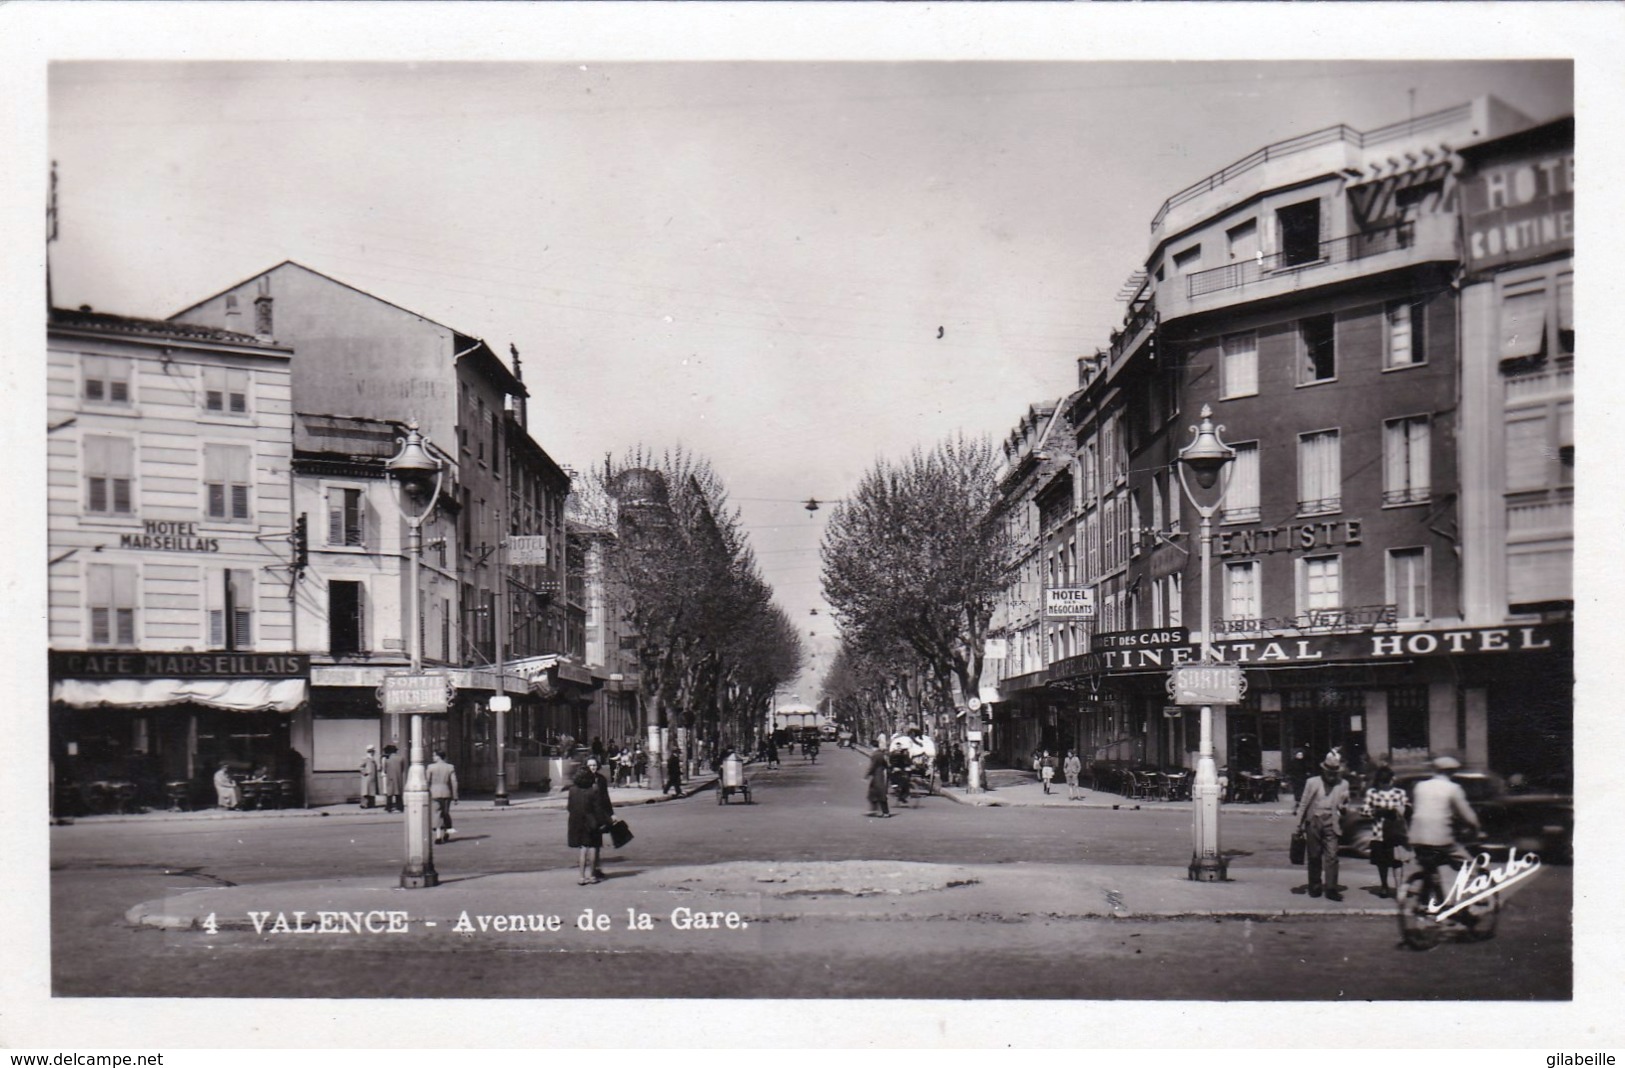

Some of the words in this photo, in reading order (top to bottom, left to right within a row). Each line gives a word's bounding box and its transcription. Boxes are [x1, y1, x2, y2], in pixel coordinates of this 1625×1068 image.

[145, 519, 196, 536] HOTEL
[120, 534, 219, 552] MARSEILLAIS
[1052, 590, 1088, 600] HOTEL
[1119, 635, 1136, 646] DES
[1139, 631, 1182, 645] CARS
[1371, 628, 1550, 656] HOTEL
[68, 654, 130, 673] CAFE
[145, 654, 299, 674] MARSEILLAIS
[387, 676, 443, 687] SORTIE
[1177, 668, 1237, 690] SORTIE
